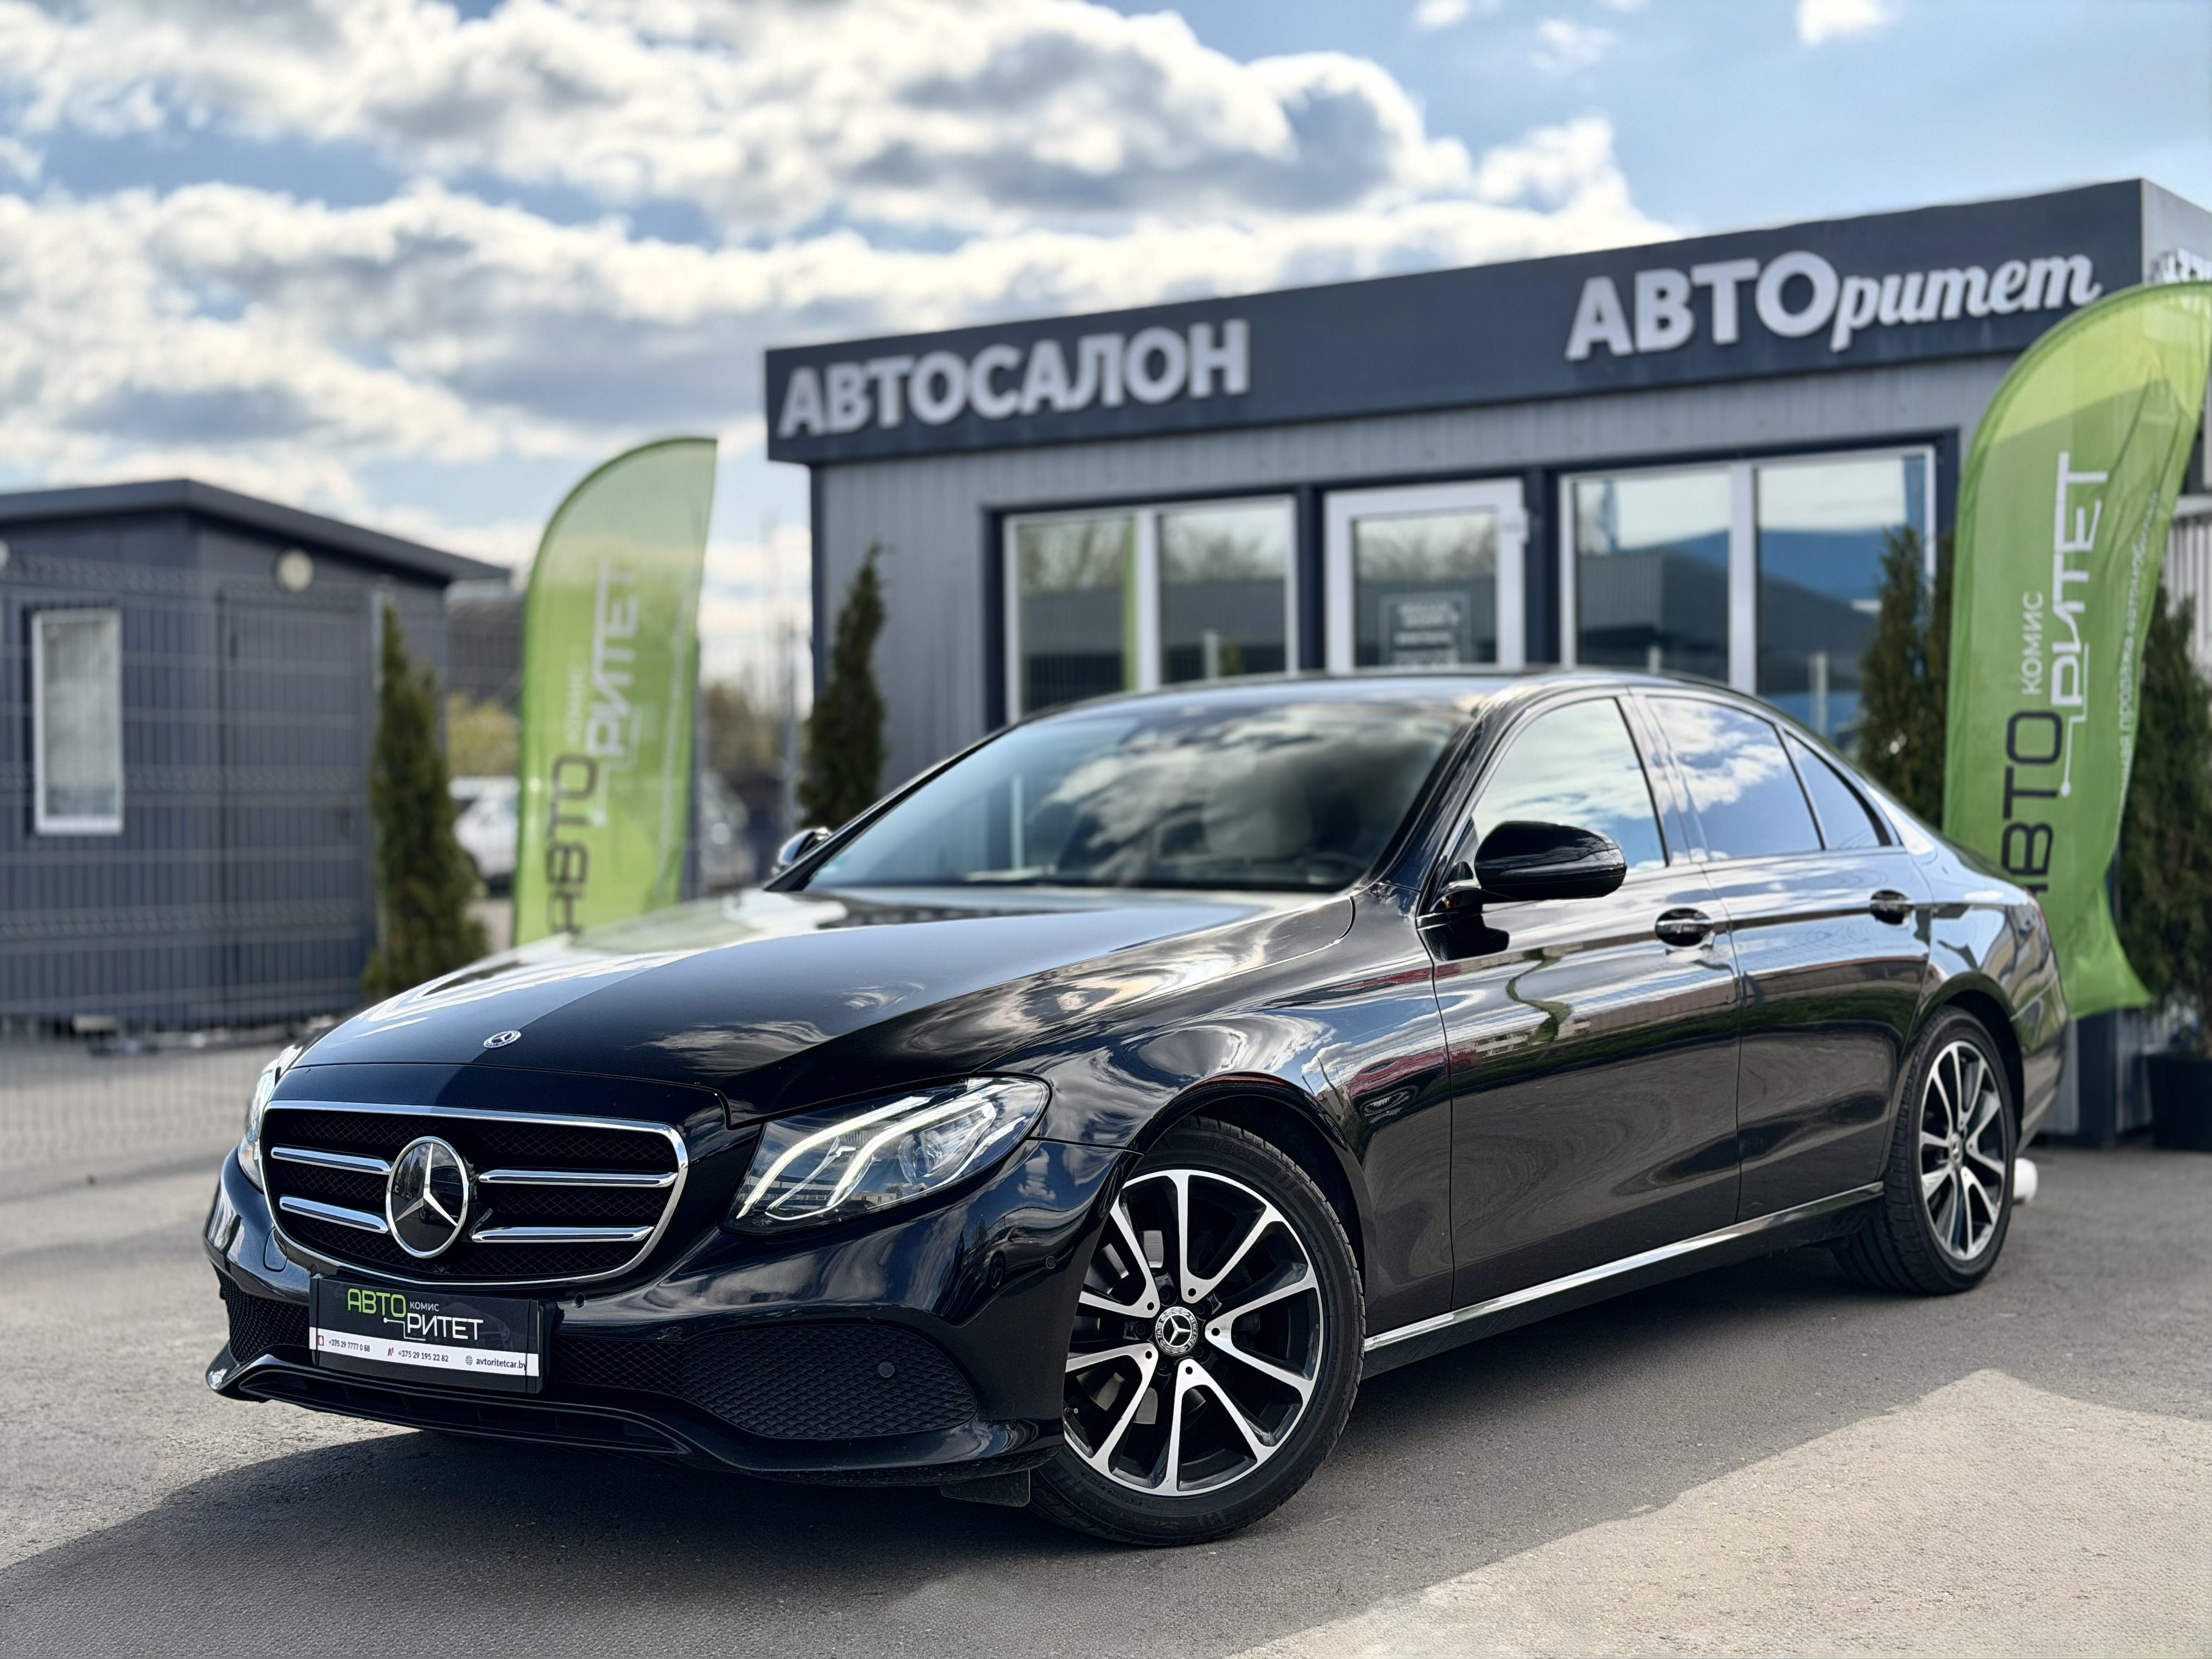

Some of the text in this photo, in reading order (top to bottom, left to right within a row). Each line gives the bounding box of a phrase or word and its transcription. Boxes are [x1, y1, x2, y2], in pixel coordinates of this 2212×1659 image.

[1565, 251, 2101, 361] АВТОритет
[777, 319, 1251, 438] АВТОСАЛОН
[2051, 452, 2108, 706] РИТЕТ
[2022, 592, 2044, 695] КОМИС
[347, 1288, 407, 1318] АВТО
[409, 1301, 439, 1312] КОМИС
[407, 1312, 484, 1340] РИТЕТ
[1188, 1315, 1197, 1347] MERCEDES
[347, 1341, 359, 1350] 7777
[398, 1350, 412, 1358] +375
[421, 1352, 432, 1361] 195
[476, 1357, 527, 1371] avtoritetcar.by
